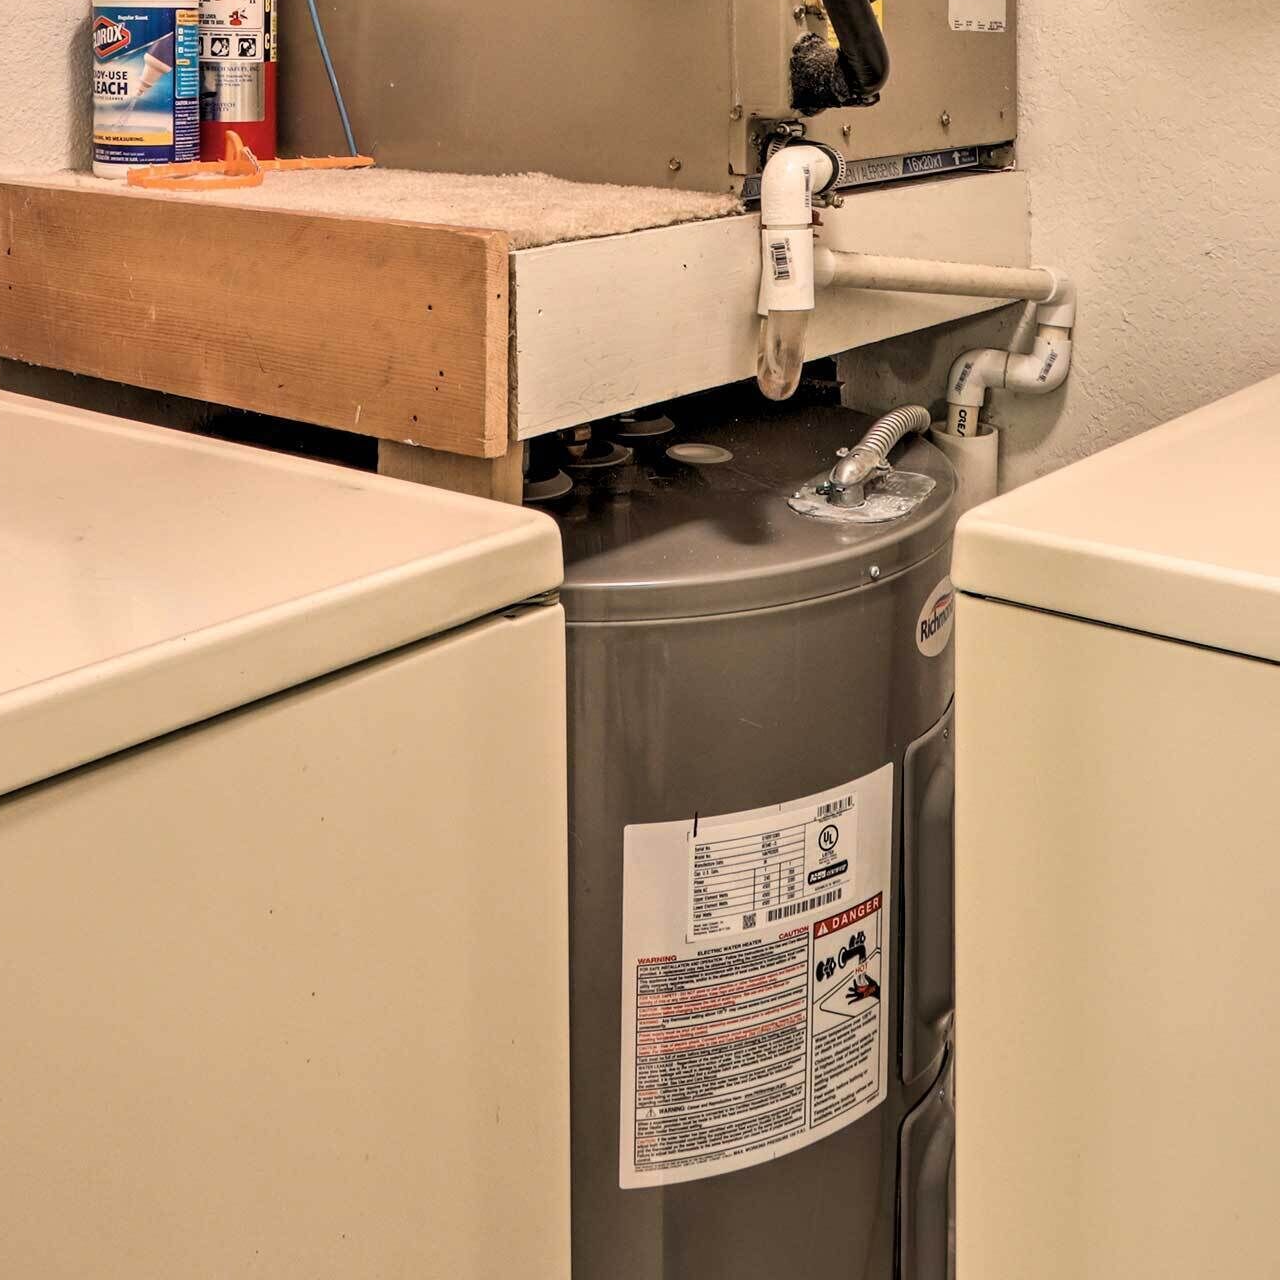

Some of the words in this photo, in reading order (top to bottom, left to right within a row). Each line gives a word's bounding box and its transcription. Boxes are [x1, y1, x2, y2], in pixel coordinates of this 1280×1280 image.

[265, 33, 270, 49] C
[906, 155, 943, 170] 16x20x1
[823, 831, 833, 845] UL
[832, 897, 879, 928] DANGER
[779, 926, 809, 940] CAUTION
[697, 948, 722, 956] ELECTRIC
[742, 940, 762, 948] HEATER
[637, 955, 677, 964] WARNING
[855, 963, 868, 974] HOT
